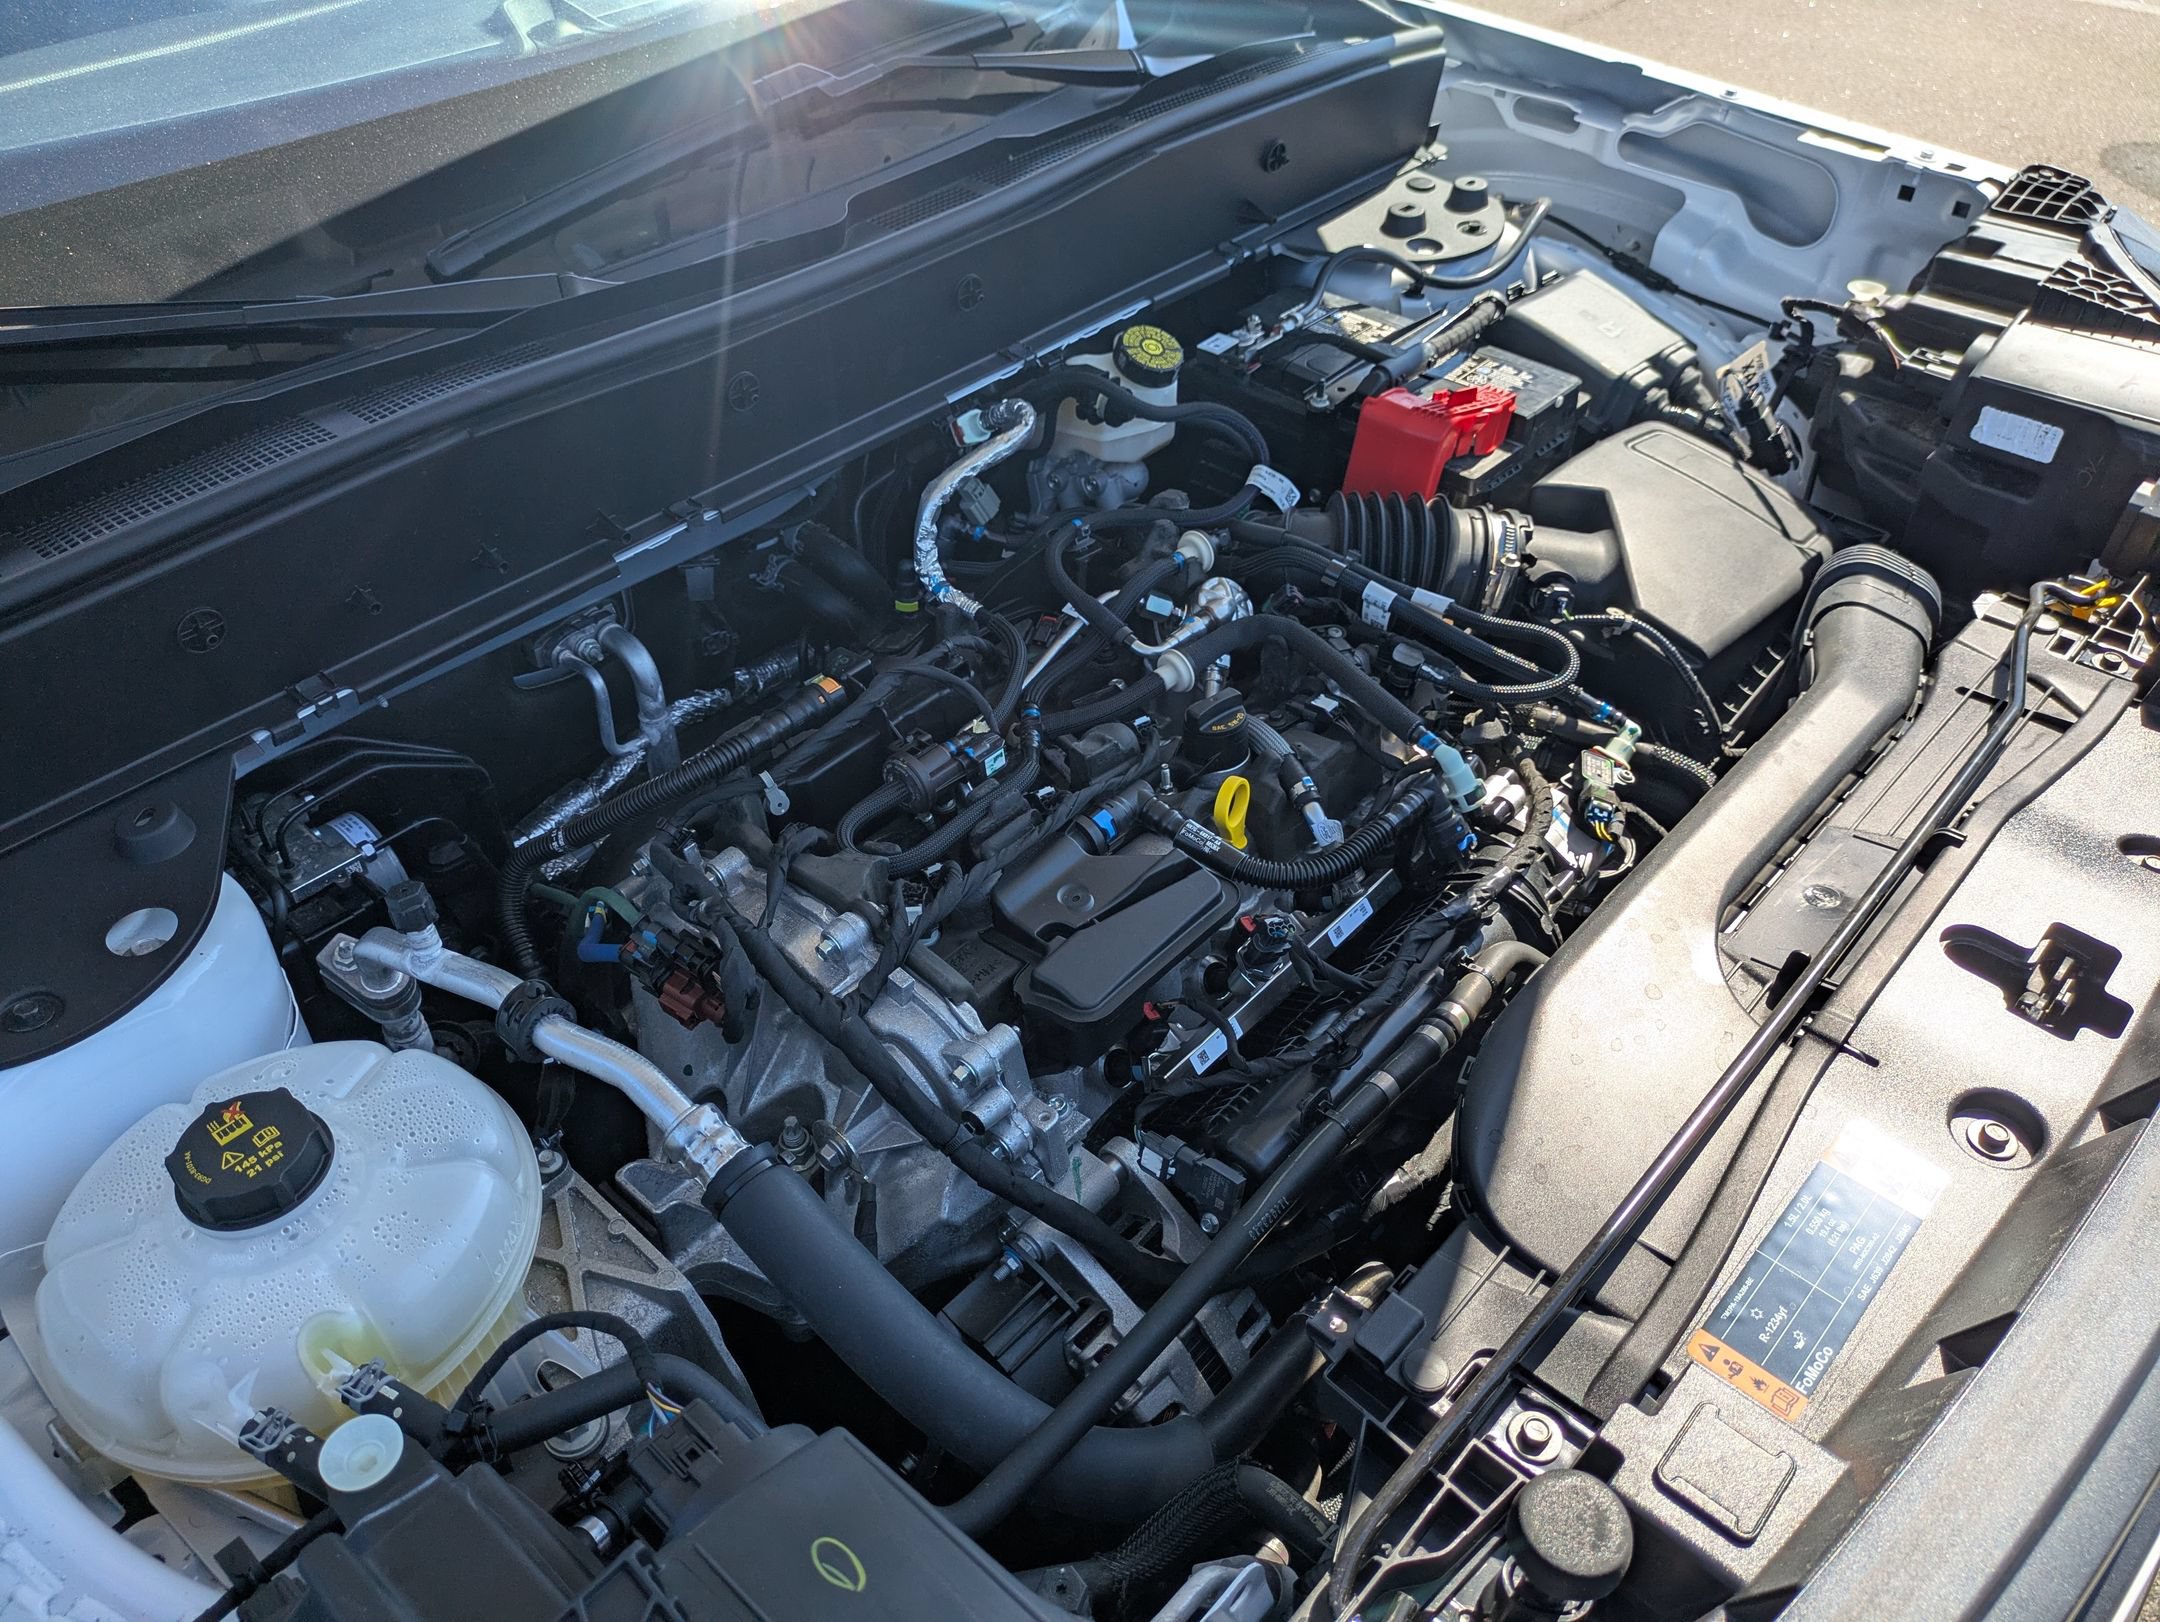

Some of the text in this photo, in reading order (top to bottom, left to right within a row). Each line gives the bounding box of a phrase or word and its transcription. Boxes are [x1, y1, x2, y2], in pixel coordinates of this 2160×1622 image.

[234, 1140, 283, 1173] 145 kPa
[246, 1150, 284, 1178] 21 psi
[1783, 1213, 1800, 1228] 1.5L
[1796, 1195, 1813, 1210] 2.0L
[1805, 1207, 1832, 1235] 0.550 kg
[1848, 1235, 1866, 1255] PAG
[1857, 1283, 1873, 1301] SAE
[1758, 1305, 1789, 1344] R-1234yf
[1794, 1345, 1834, 1395] FoMoCo
